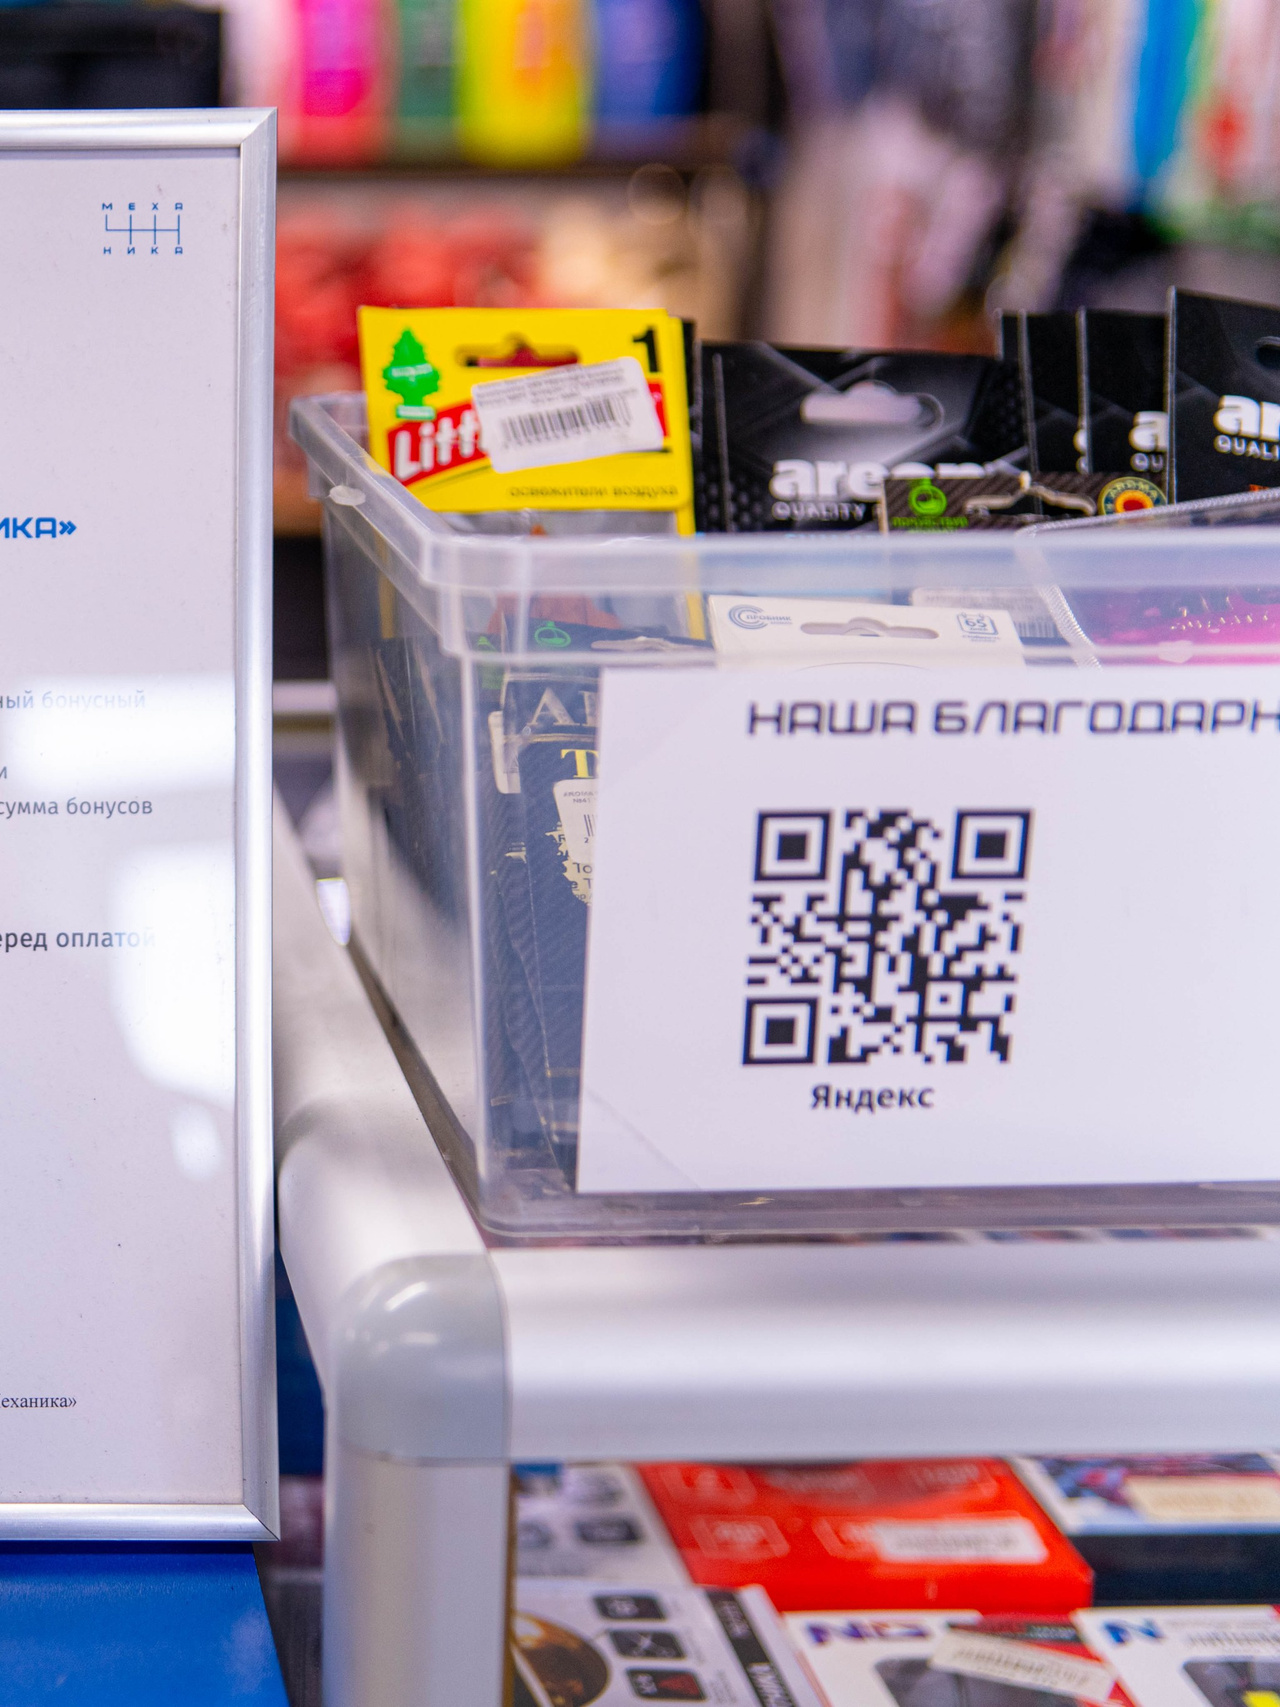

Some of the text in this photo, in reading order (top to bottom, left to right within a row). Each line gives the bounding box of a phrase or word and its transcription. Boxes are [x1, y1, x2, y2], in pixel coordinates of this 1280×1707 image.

[394, 409, 481, 480] Litt
[747, 700, 919, 736] НАША
[66, 796, 153, 820] бонусов
[810, 1083, 934, 1113] Яндекс
